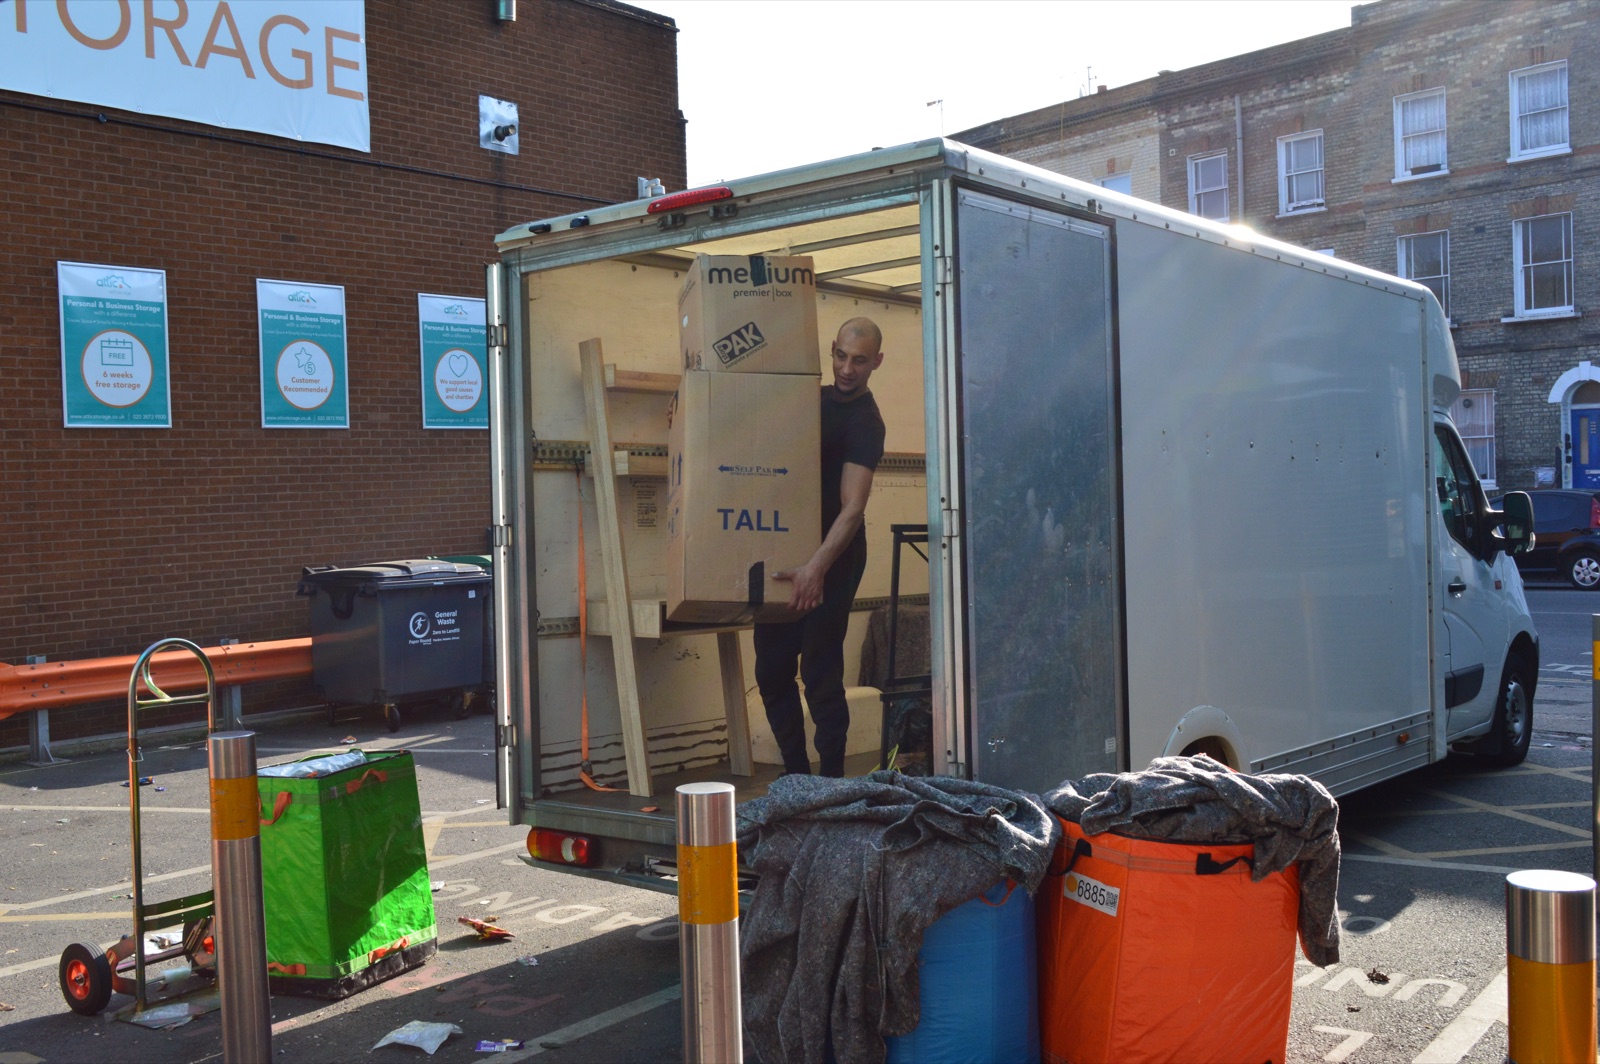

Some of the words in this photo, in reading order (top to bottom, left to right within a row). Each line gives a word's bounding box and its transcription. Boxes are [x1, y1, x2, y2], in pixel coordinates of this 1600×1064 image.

[708, 262, 813, 286] meium
[733, 289, 771, 299] premier
[775, 288, 792, 298] box
[66, 299, 97, 308] Personal
[105, 302, 134, 311] Business
[135, 303, 161, 314] Storage
[263, 312, 289, 320] Personal
[295, 314, 319, 322] Business
[319, 316, 341, 325] Storage
[450, 325, 470, 333] Business
[715, 323, 763, 361] PAK
[108, 352, 126, 360] FREE
[307, 363, 313, 373] 5
[110, 371, 133, 379] weeks
[291, 376, 320, 384] Customer
[95, 380, 111, 388] free
[112, 381, 141, 390] storage
[283, 385, 328, 393] Recommended
[734, 465, 754, 473] SELF
[756, 465, 772, 474] PAK
[717, 508, 789, 532] TALL
[435, 610, 457, 618] General
[1077, 879, 1106, 906] 6885
